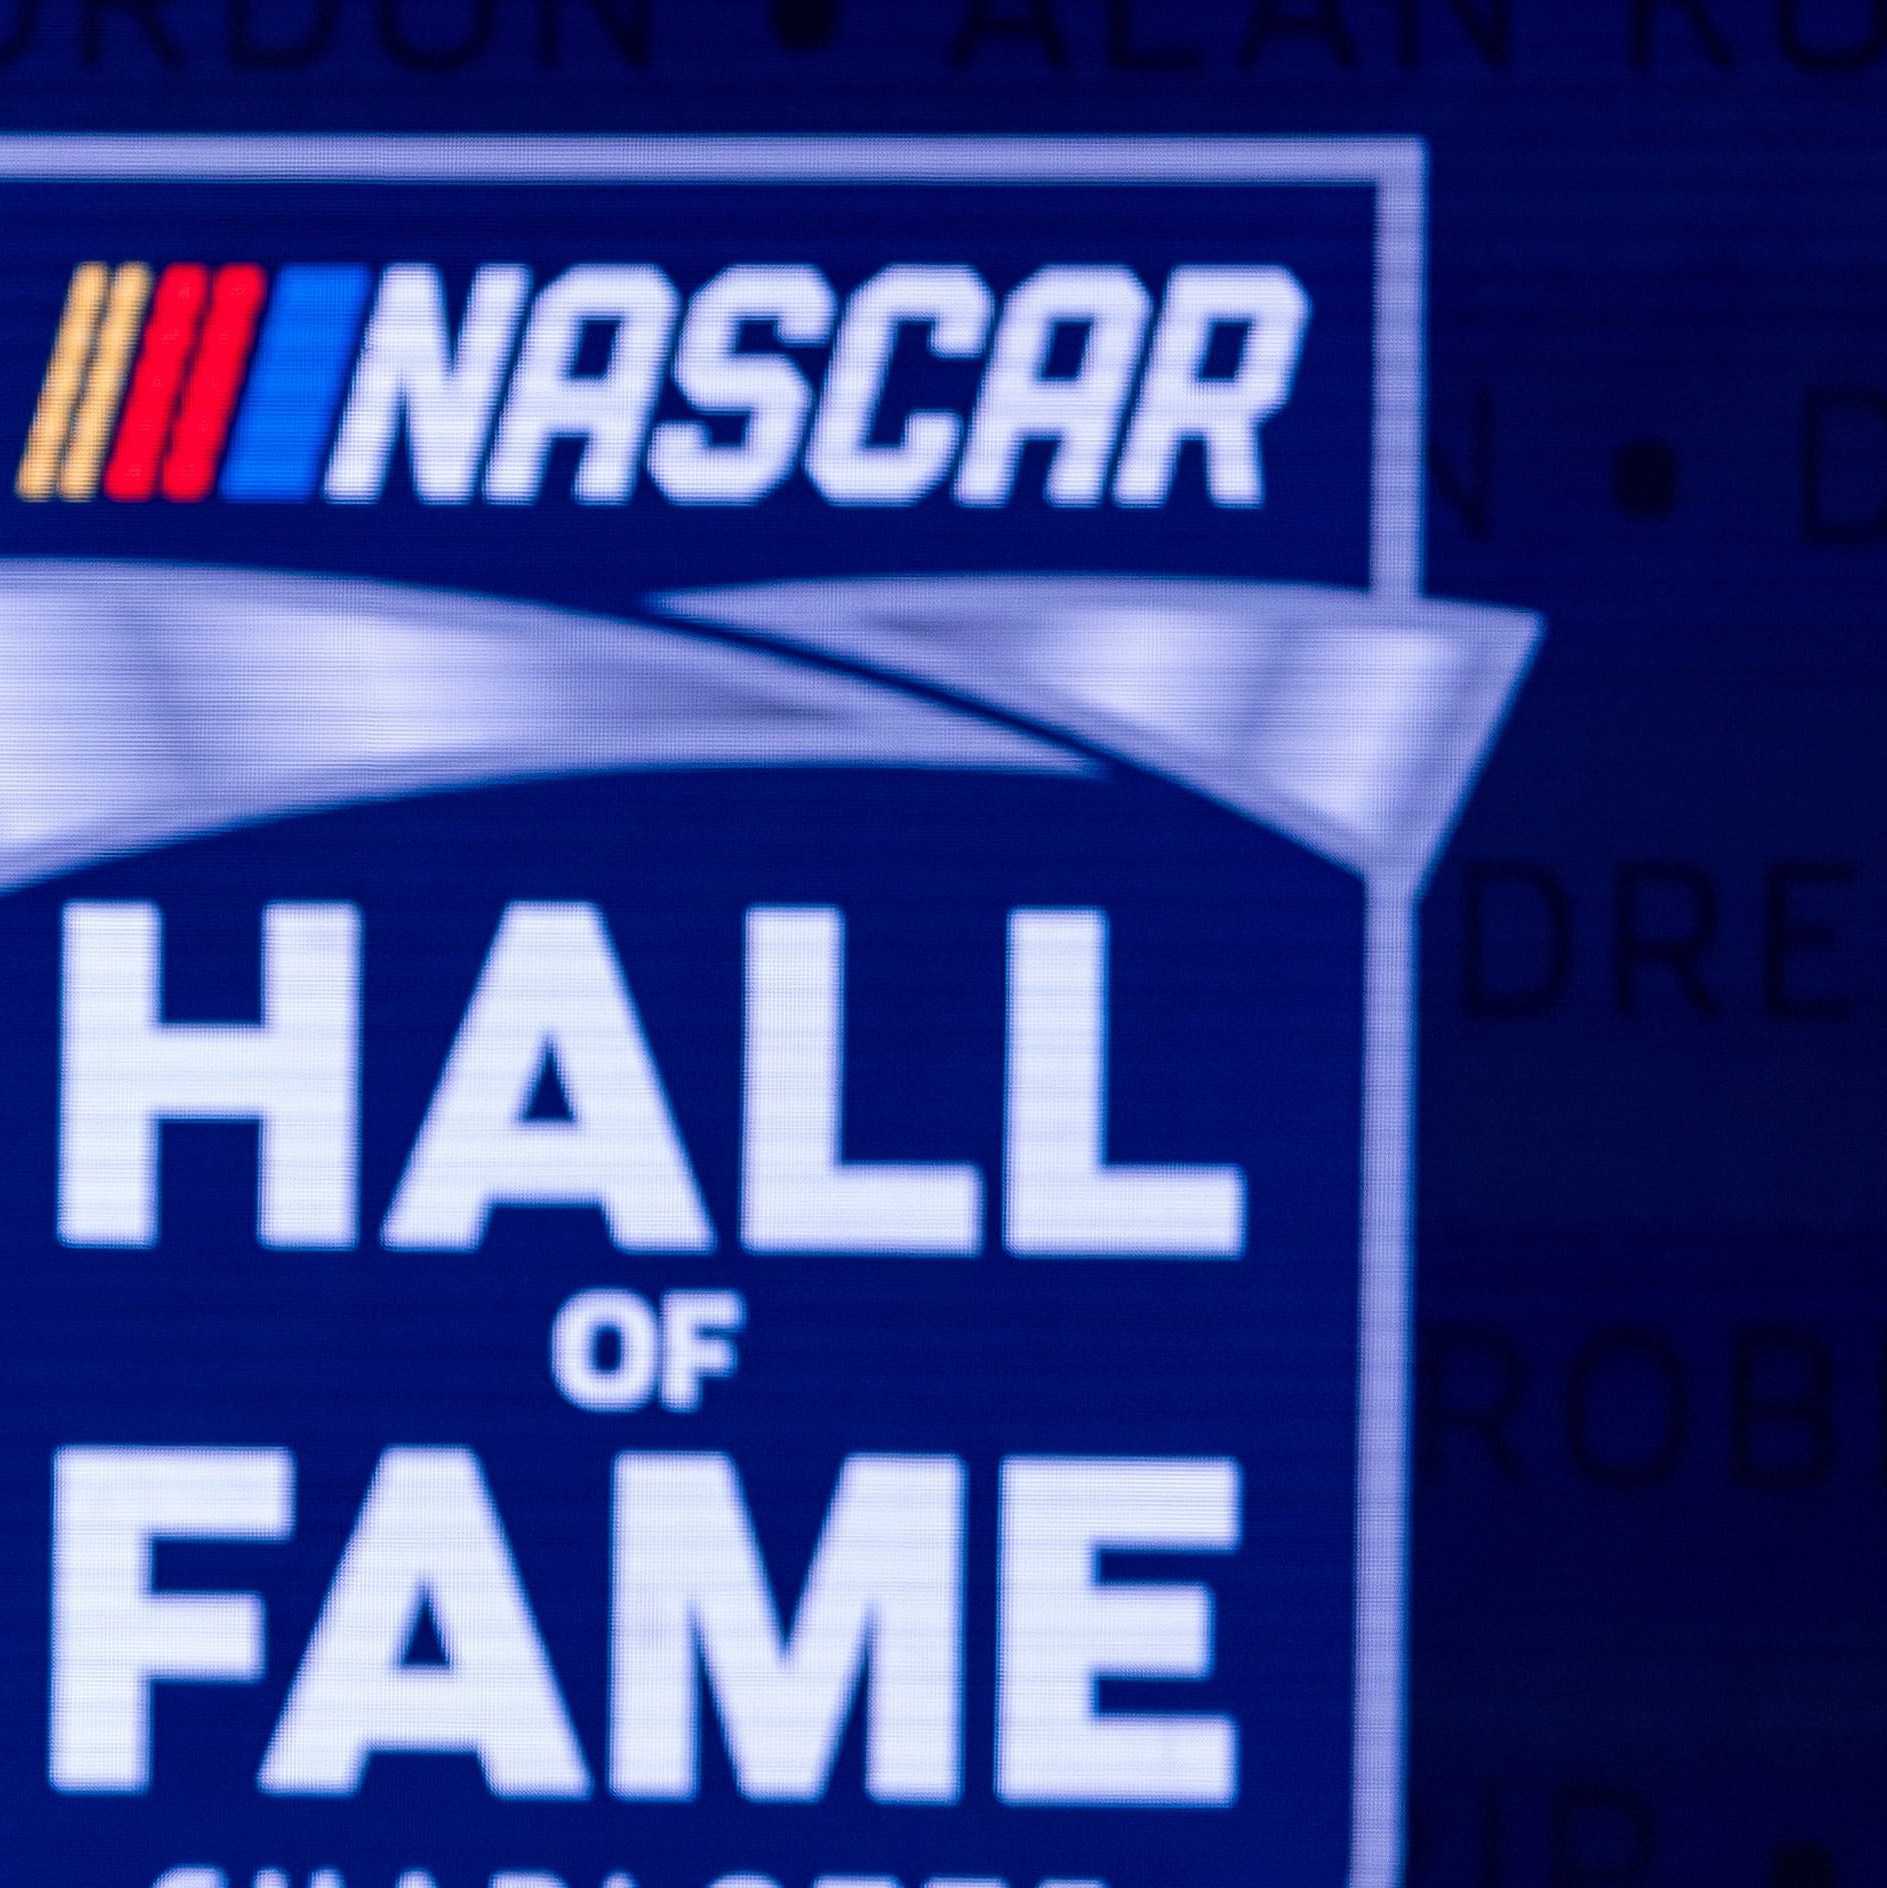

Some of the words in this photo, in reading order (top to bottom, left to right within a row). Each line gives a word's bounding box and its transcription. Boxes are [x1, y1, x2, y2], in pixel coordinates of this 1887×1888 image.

[324, 261, 1308, 505] NASCAR
[56, 900, 1245, 1258] HALL
[549, 1288, 744, 1412] OF
[46, 1445, 1241, 1806] FAME
